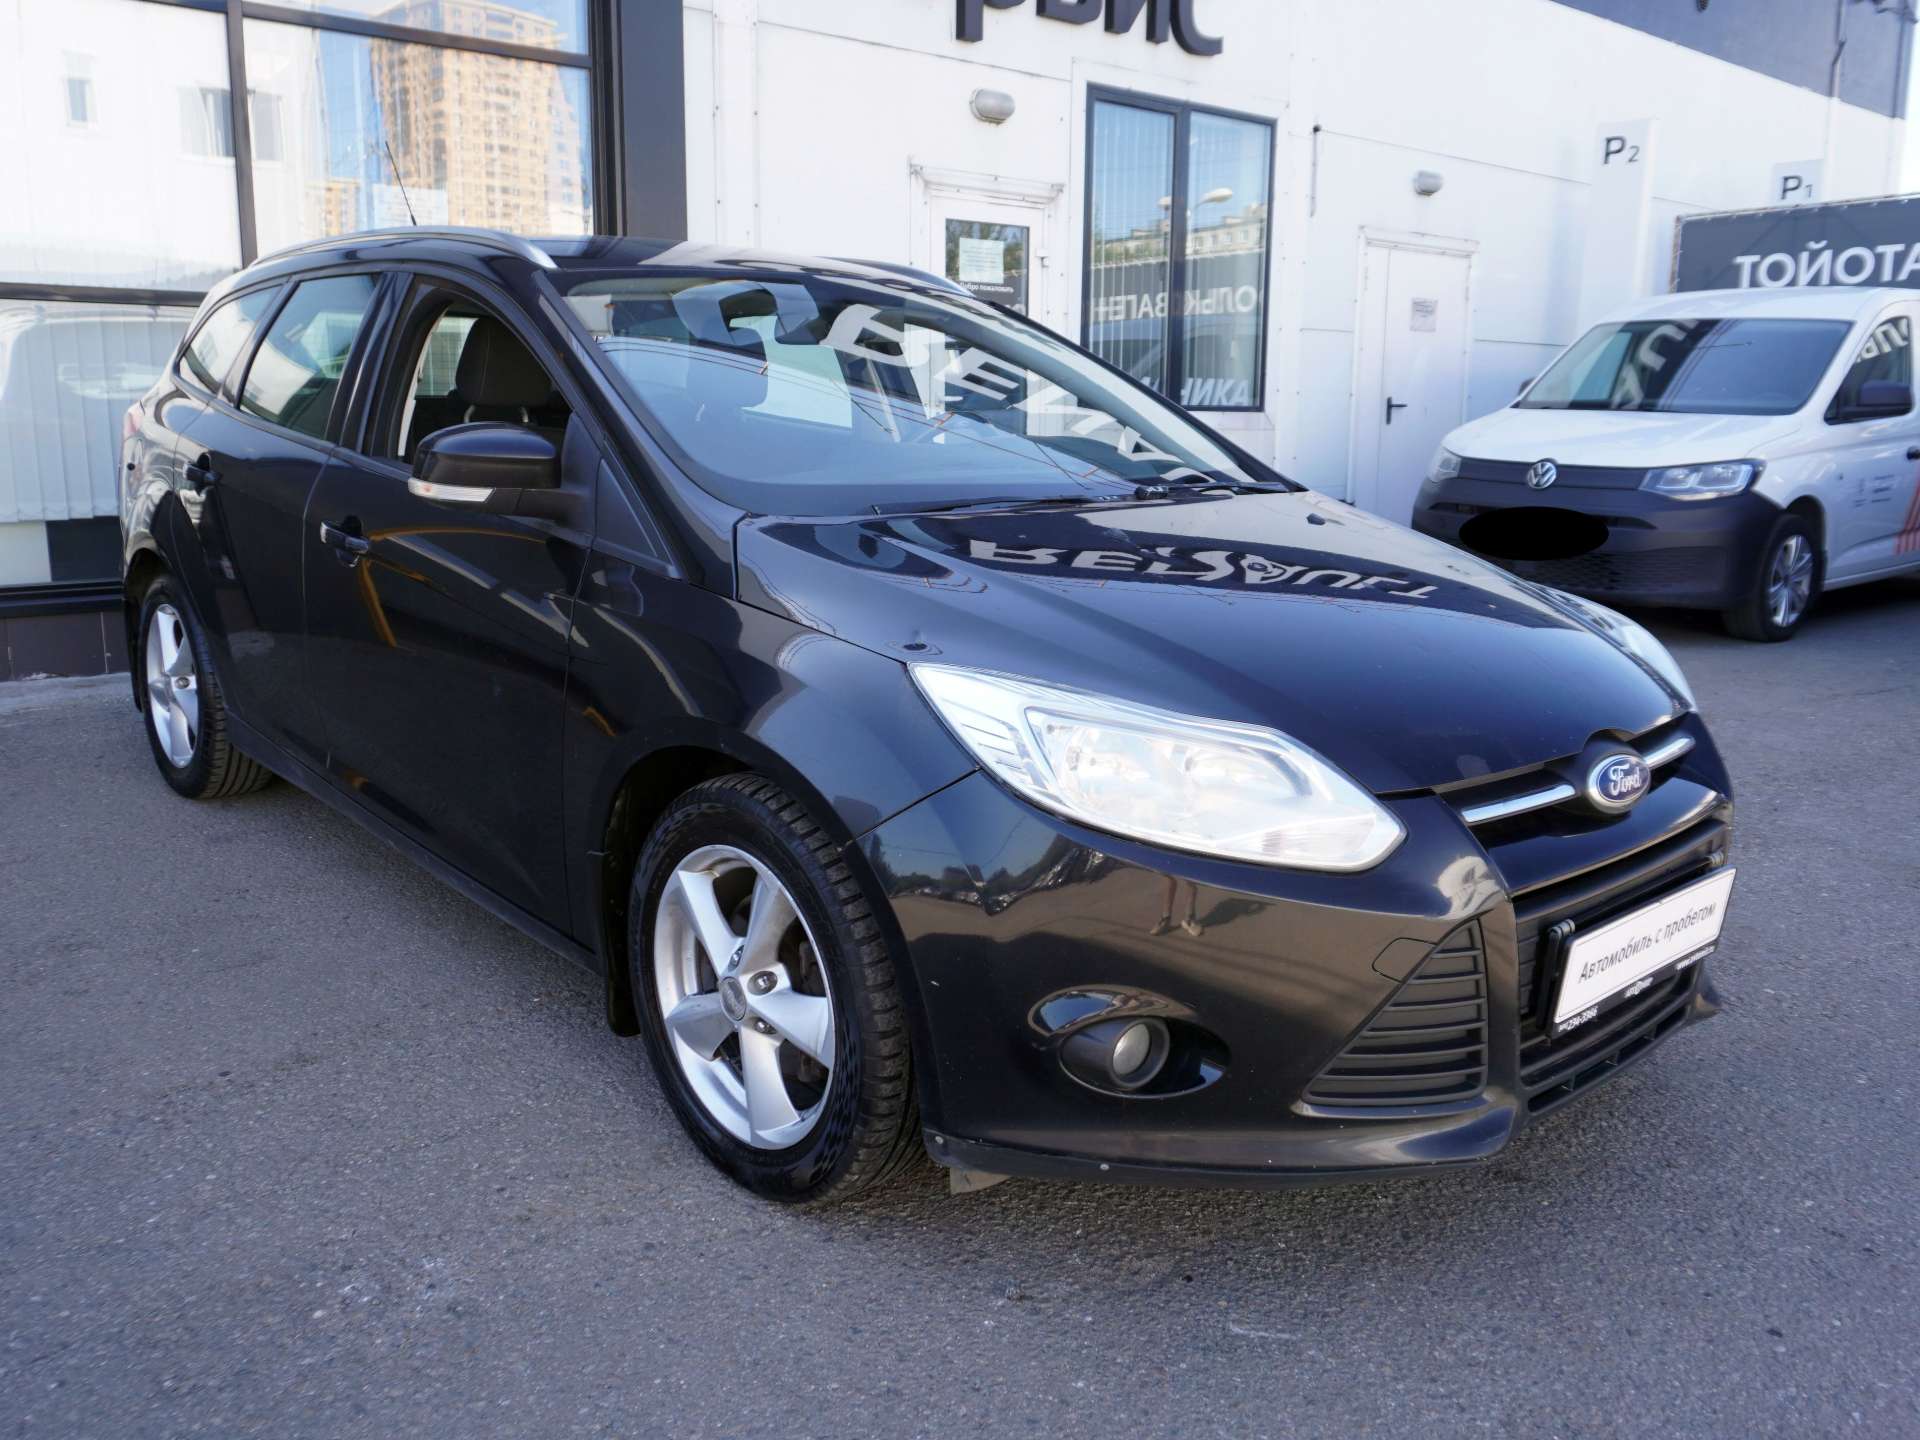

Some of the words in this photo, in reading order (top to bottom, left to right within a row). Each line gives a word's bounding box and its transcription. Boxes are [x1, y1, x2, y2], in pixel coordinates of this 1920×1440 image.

[1608, 763, 1641, 797] Ford
[1578, 930, 1653, 984] Автомобиль
[1663, 903, 1717, 941] пробегом
